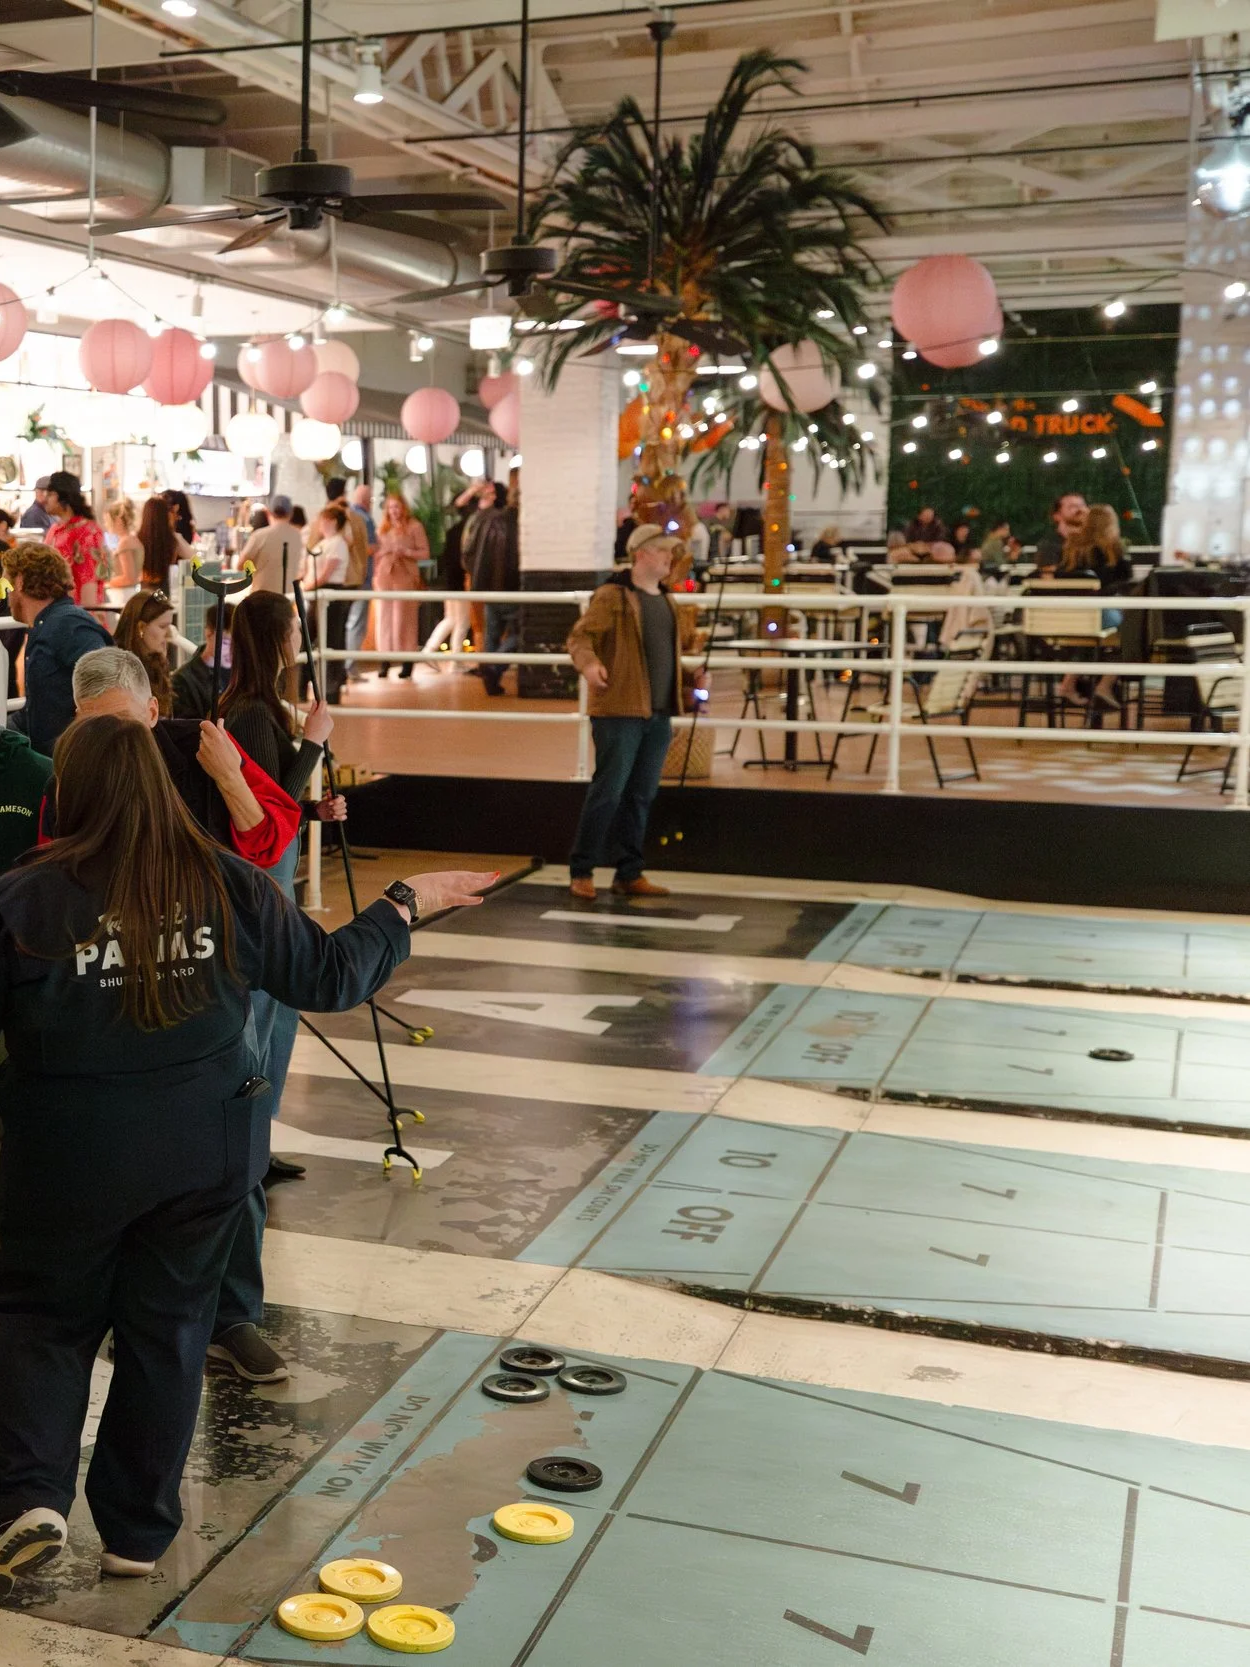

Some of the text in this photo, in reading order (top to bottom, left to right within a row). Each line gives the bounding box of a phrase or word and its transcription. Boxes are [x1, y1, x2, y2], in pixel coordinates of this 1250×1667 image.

[1034, 413, 1114, 435] TRUCK
[75, 926, 215, 976] PAMS
[718, 1149, 778, 1169] 10
[661, 1205, 735, 1244] OFF
[399, 1395, 431, 1411] DO
[315, 1476, 353, 1498] ON
[840, 1470, 921, 1506] 7
[783, 1608, 875, 1656] 7
